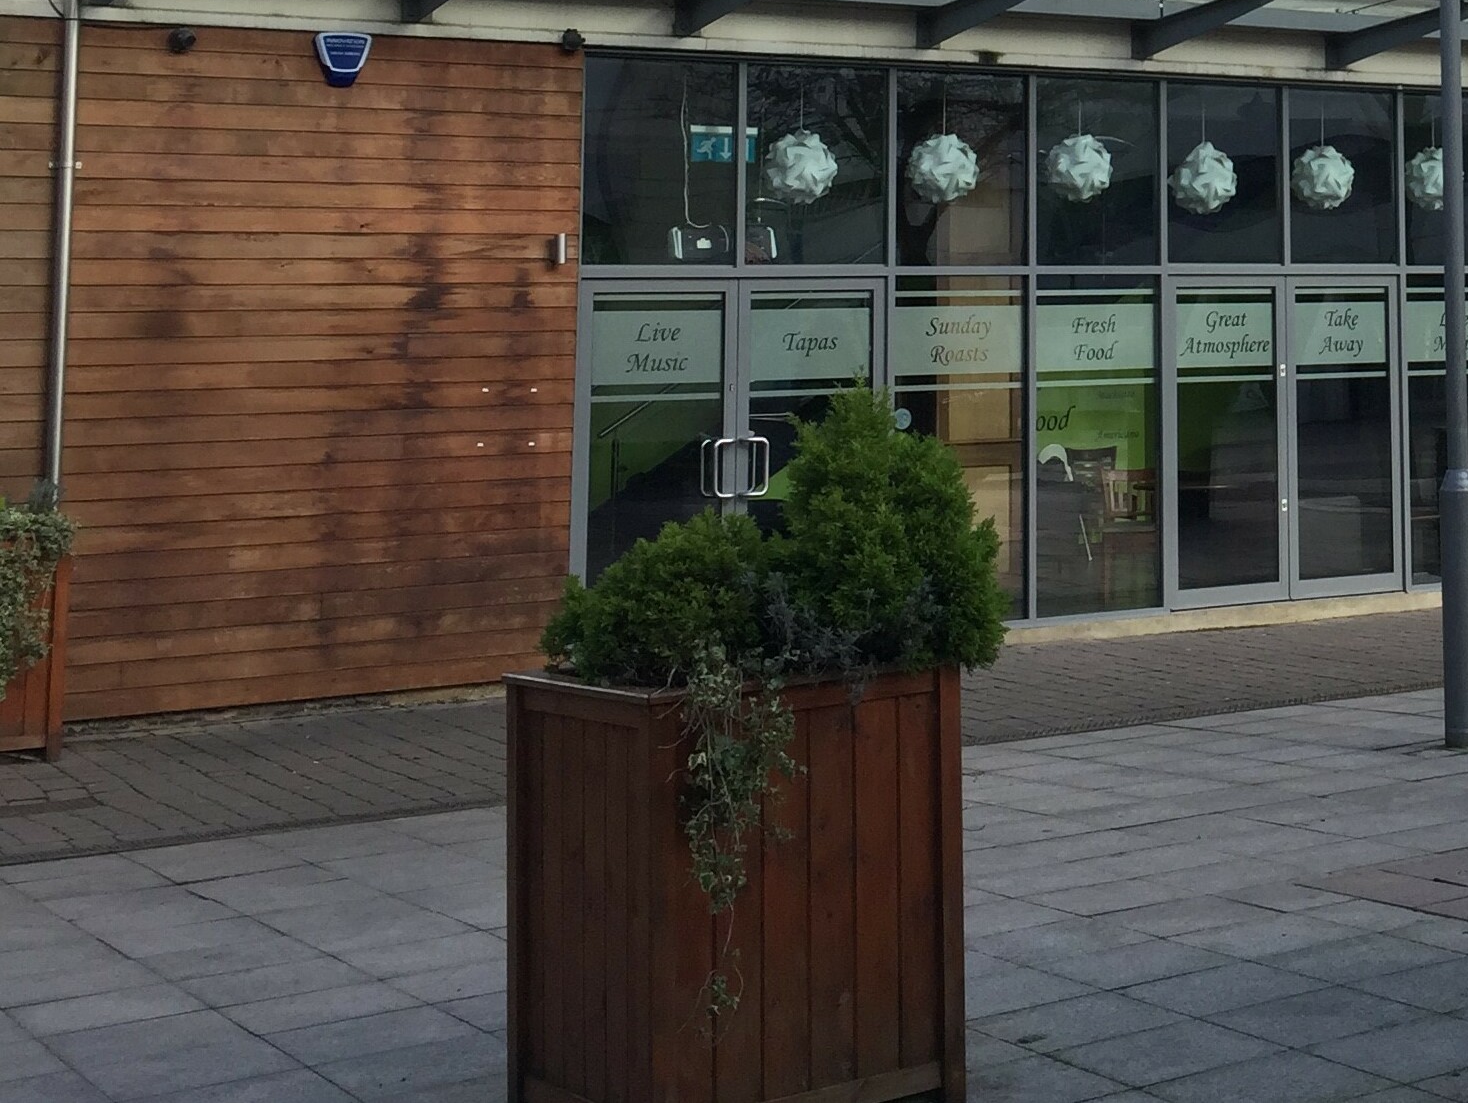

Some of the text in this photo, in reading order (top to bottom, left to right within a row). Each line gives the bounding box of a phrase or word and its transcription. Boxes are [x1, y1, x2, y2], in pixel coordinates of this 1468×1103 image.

[926, 314, 992, 341] Sunday
[1072, 313, 1117, 334] Fresh
[1205, 310, 1248, 334] Great
[1323, 308, 1360, 331] Take
[634, 322, 682, 343] Live
[782, 332, 838, 358] Tapas
[930, 344, 989, 366] Roasts
[1073, 340, 1120, 362] Food
[1179, 333, 1271, 359] Atmosphere
[1318, 334, 1364, 358] Away
[624, 352, 689, 374] Music
[1036, 404, 1077, 432] ood
